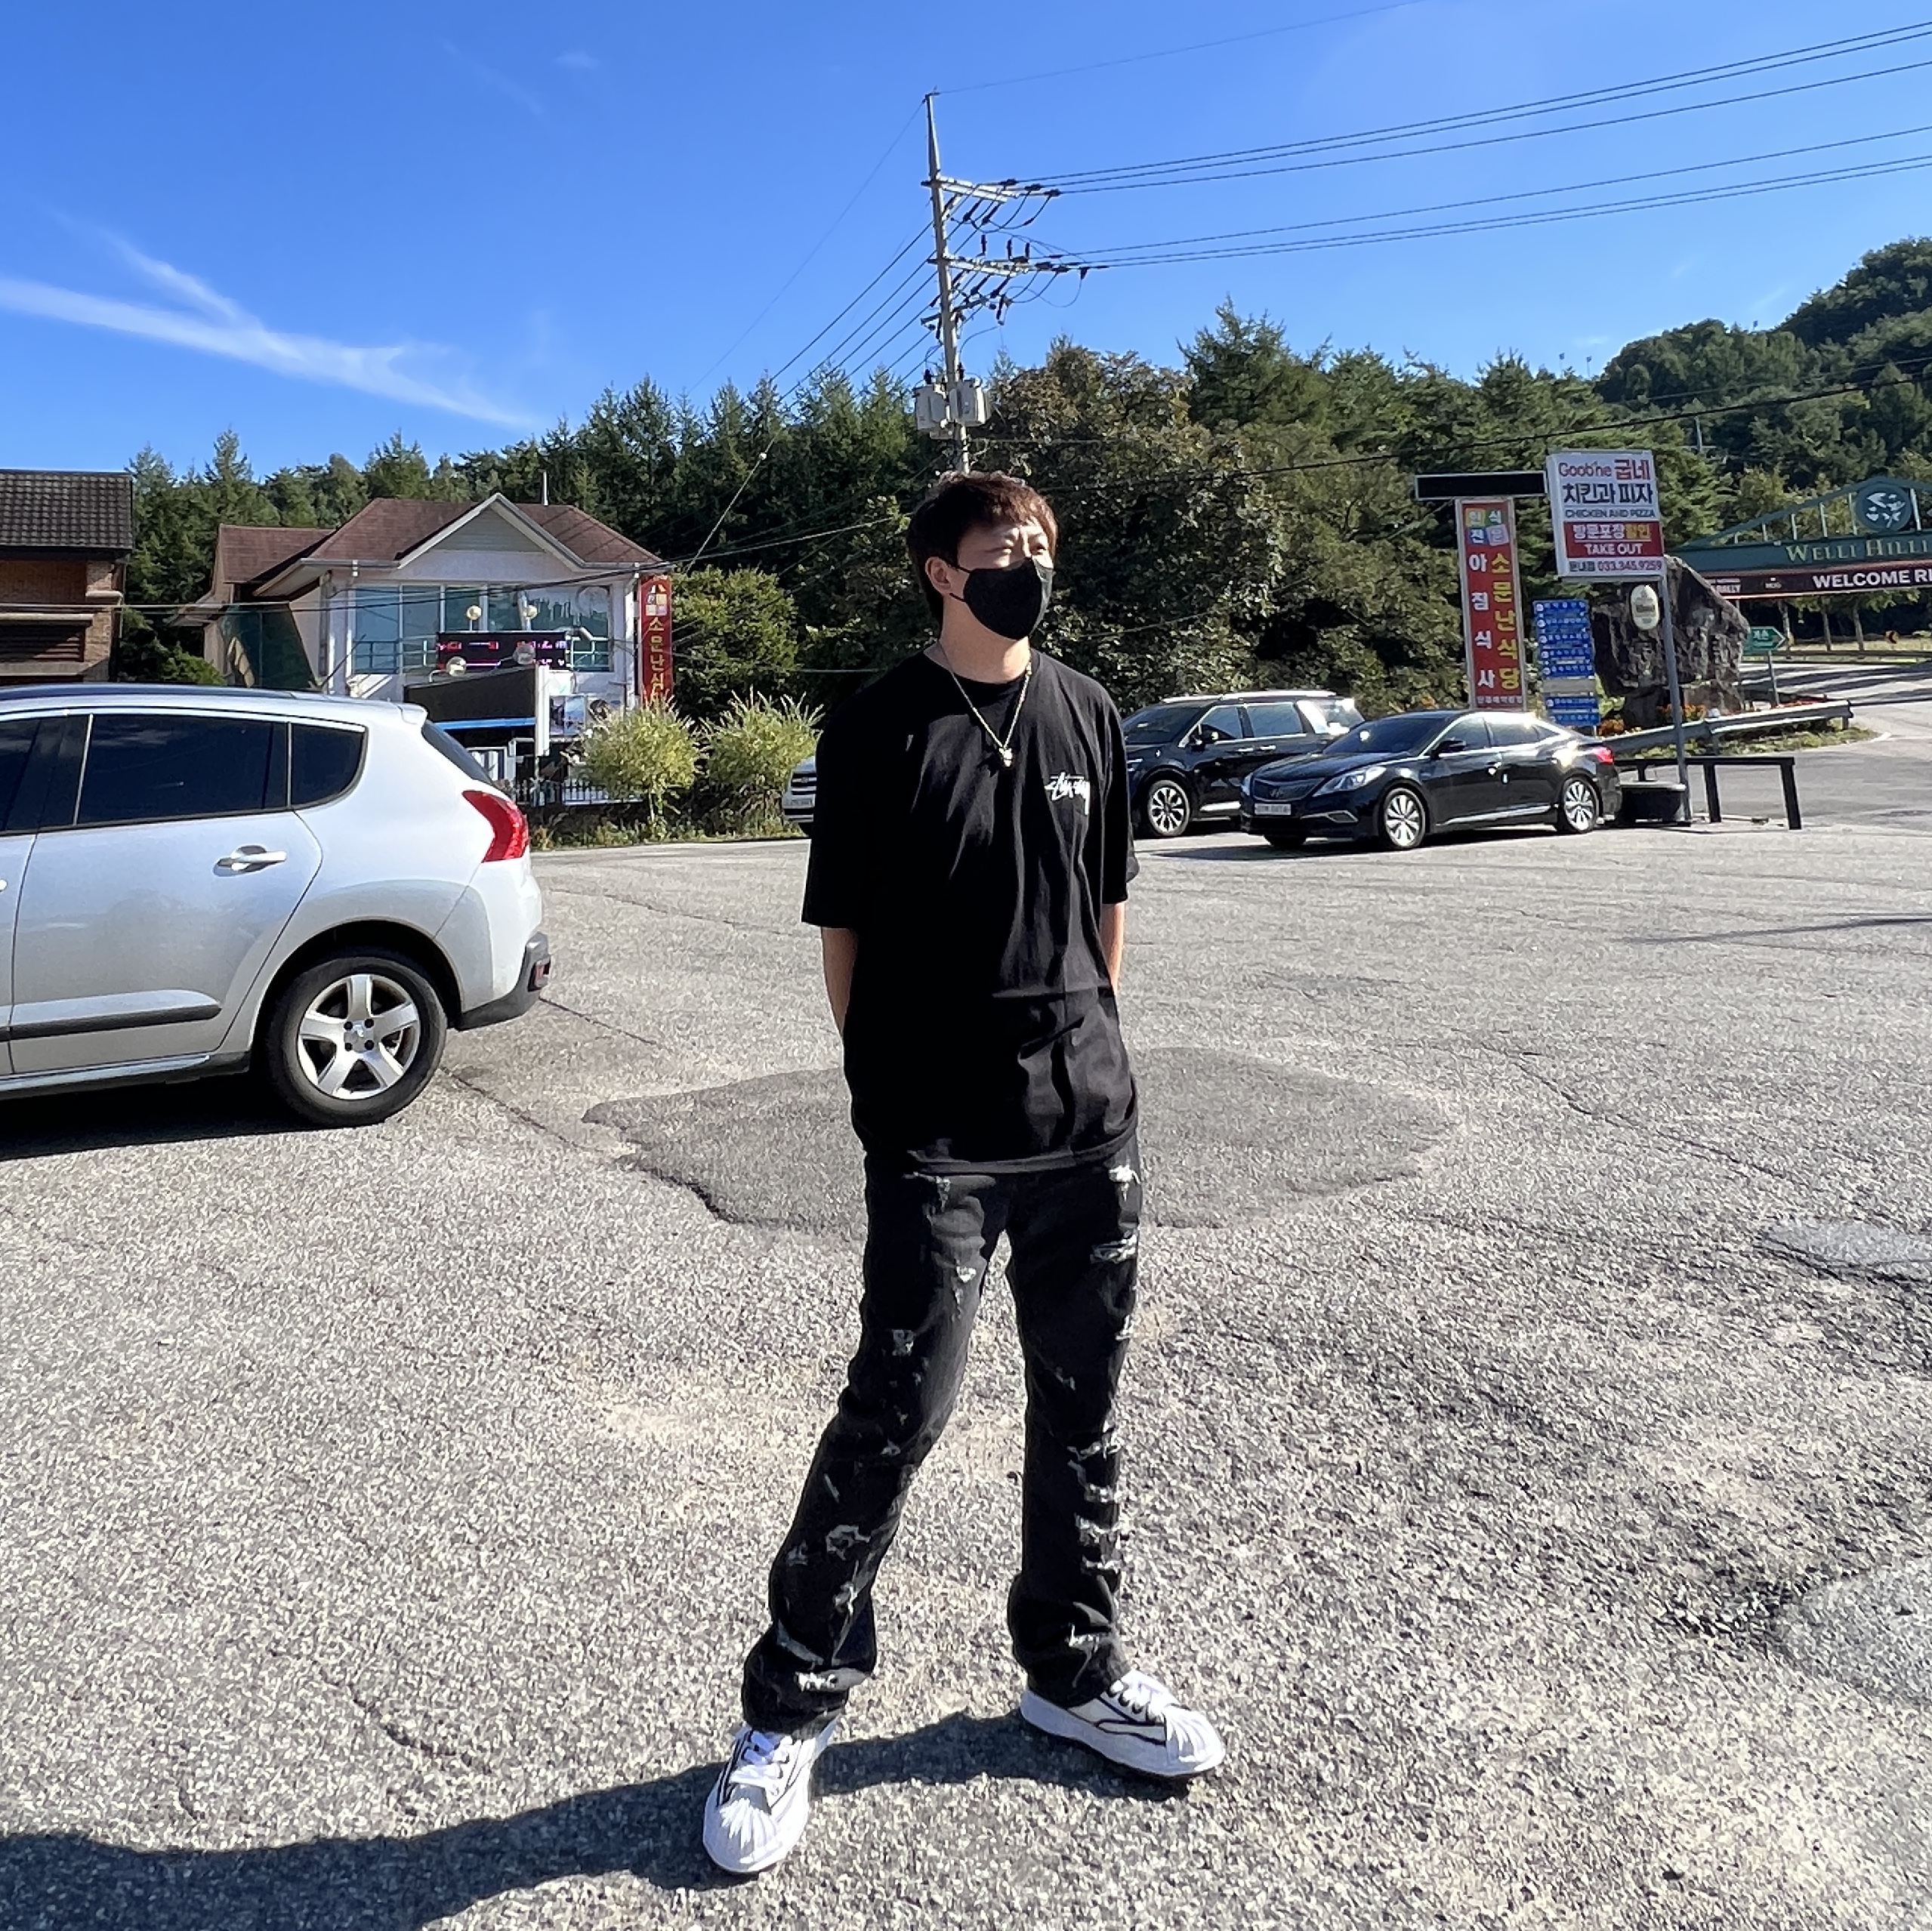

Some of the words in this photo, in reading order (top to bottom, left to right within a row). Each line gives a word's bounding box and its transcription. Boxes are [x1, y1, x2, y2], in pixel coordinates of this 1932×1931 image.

[1614, 459, 1651, 480] 굽네
[1562, 483, 1616, 504] 치킨과
[1618, 483, 1653, 504] 피자
[1565, 509, 1607, 518] CHICKEN
[1609, 509, 1628, 518] AND
[1630, 509, 1656, 518] PIZZA
[1584, 543, 1616, 555] TAKE
[1617, 543, 1643, 554] OUT
[1785, 543, 1857, 562] WELLI
[1865, 538, 1929, 557] HILLI
[1813, 569, 1911, 589] WELCOME
[648, 616, 665, 690] 소문난식
